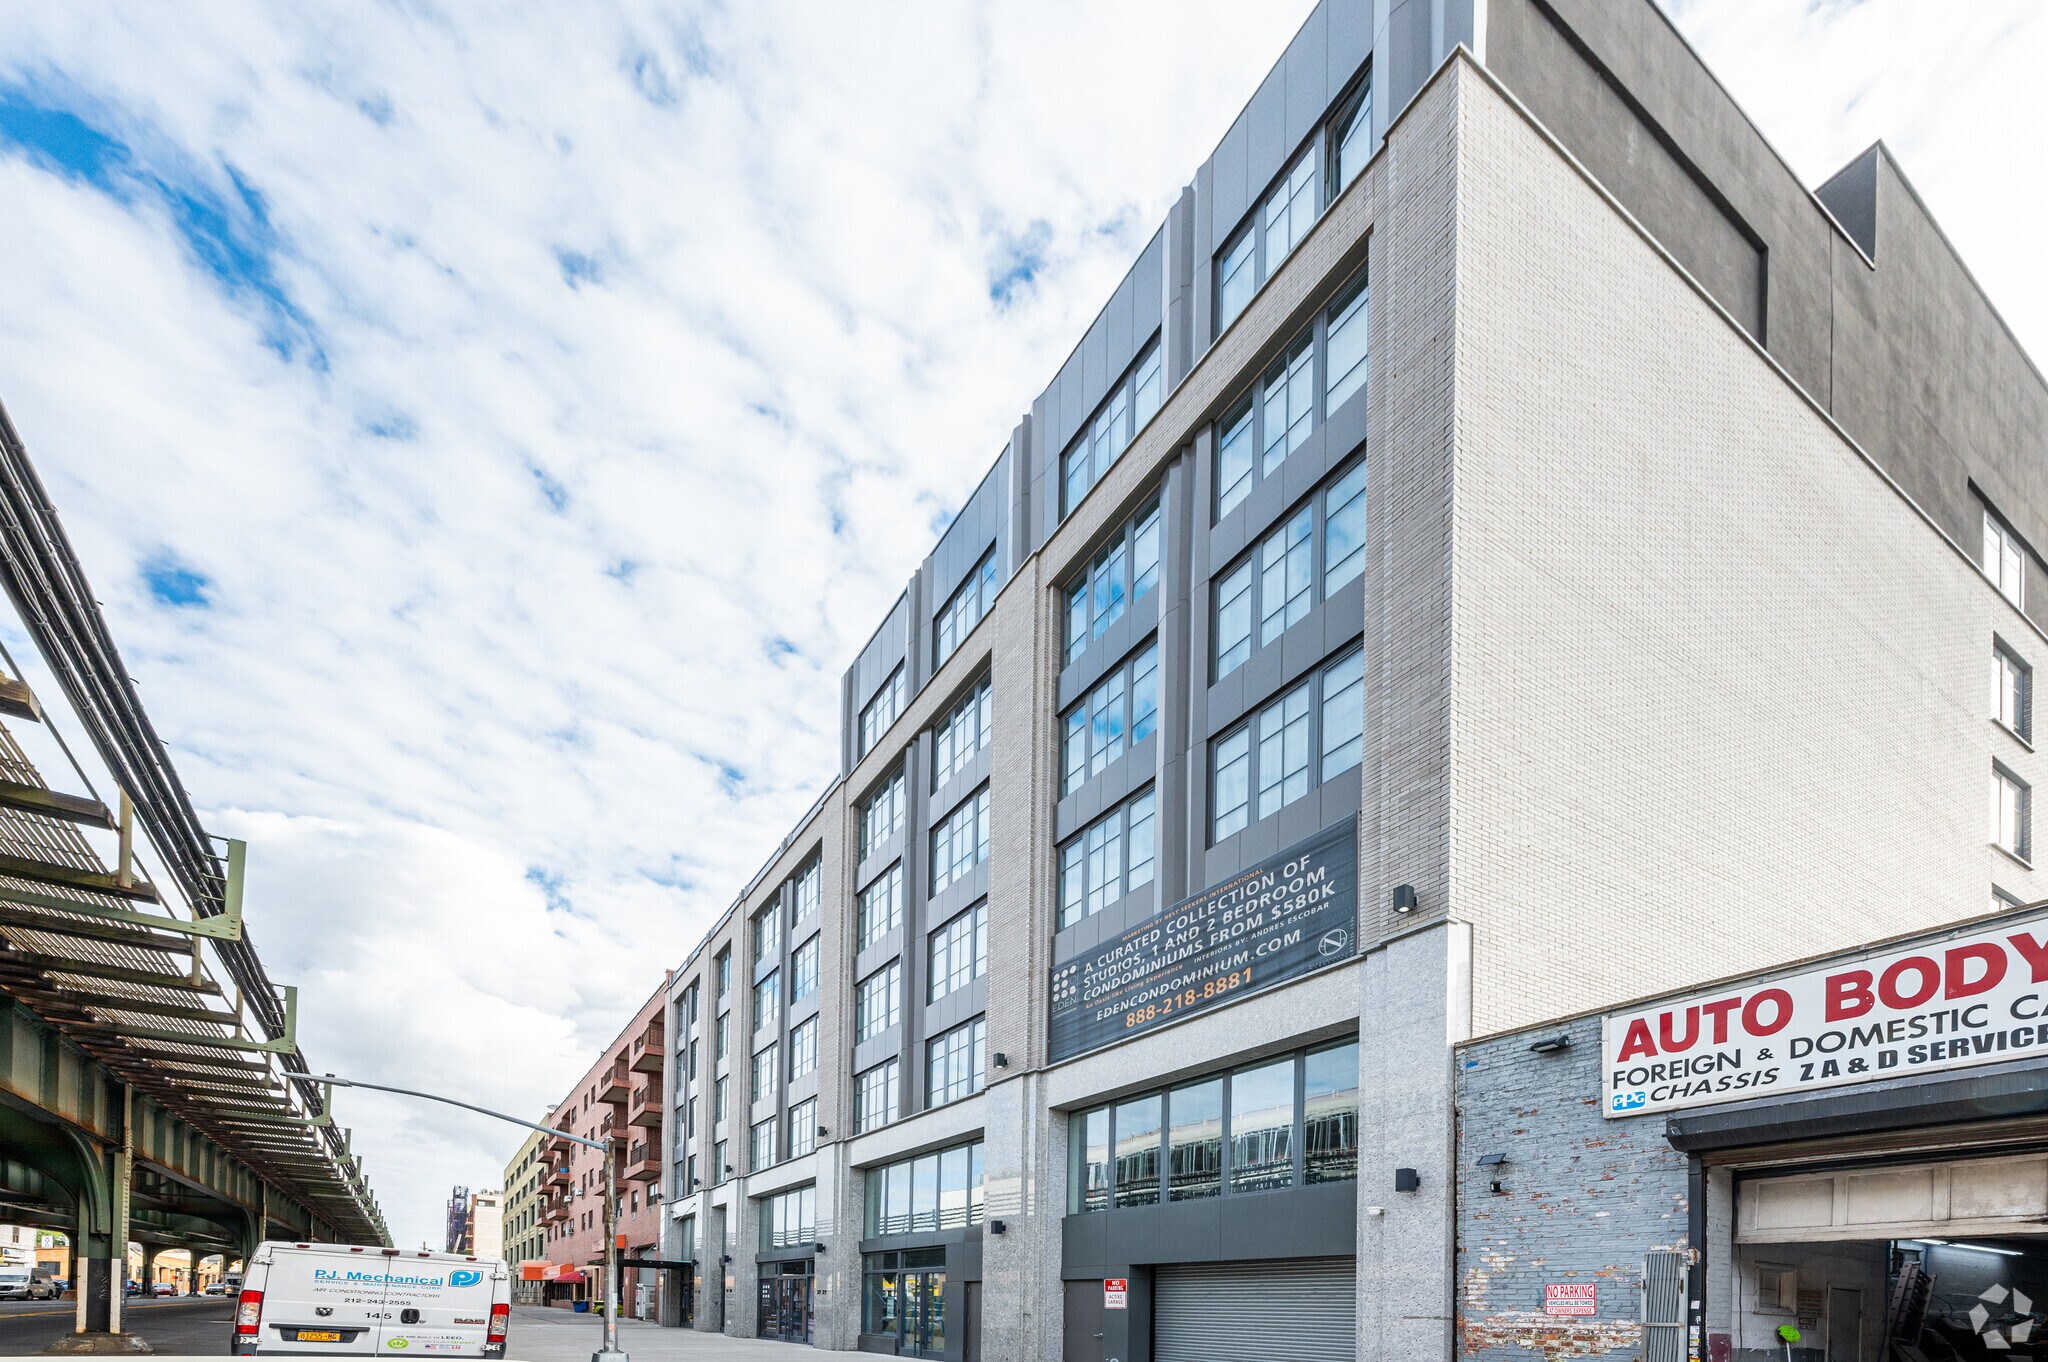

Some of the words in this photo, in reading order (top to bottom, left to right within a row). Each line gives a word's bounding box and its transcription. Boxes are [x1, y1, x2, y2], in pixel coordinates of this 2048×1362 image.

[1083, 952, 1145, 989] STUDIOS,
[1151, 944, 1158, 956] 1
[1164, 926, 1200, 952] AND
[1206, 918, 1216, 933] 2
[1223, 865, 1326, 925] BEDROOM
[1084, 962, 1093, 975] A
[1097, 929, 1160, 968] CURATED
[1166, 871, 1275, 934] COLLECTION
[1283, 854, 1310, 879] OF
[1122, 923, 1154, 941] MARKETING
[1155, 917, 1163, 925] BY
[1164, 910, 1179, 920] NEST
[1180, 895, 1208, 913] SEEKERS
[1209, 867, 1265, 898] INTERNATIONAL
[1193, 943, 1233, 964] INTERIORS
[1235, 937, 1248, 946] BY:
[1250, 920, 1284, 941] ANDRES
[1287, 901, 1330, 925] ESCOBAR
[1083, 940, 1203, 1001] CONDOMINIUMS
[1210, 912, 1263, 947] FROM
[1271, 880, 1336, 921] $580K
[1052, 995, 1077, 1013] EDEN
[1096, 928, 1301, 1022] EDENCONDOMINIUM.COM
[1125, 981, 1144, 994] Living
[1146, 963, 1183, 984] Experience
[1125, 966, 1252, 1028] 888-218-8881
[1616, 988, 1794, 1063] AUTO
[1825, 931, 2048, 1023] BODY
[1613, 1048, 1742, 1090] FOREIGN
[1756, 1048, 1775, 1061] &
[1790, 1003, 1988, 1061] DOMESTIC
[1650, 1067, 1781, 1102] CHASSIS
[1847, 1057, 1869, 1074] &
[1877, 1049, 1898, 1070] D
[1612, 1092, 1646, 1109] PPG
[315, 1269, 340, 1279] P.J.
[346, 1271, 444, 1286] Mechanical
[329, 1288, 384, 1296] CONDITIONING
[385, 1291, 440, 1299] CONTRACTORS
[344, 1298, 412, 1306] 212-243-2555
[1547, 1285, 1559, 1298] NO
[1560, 1285, 1593, 1298] PARKING
